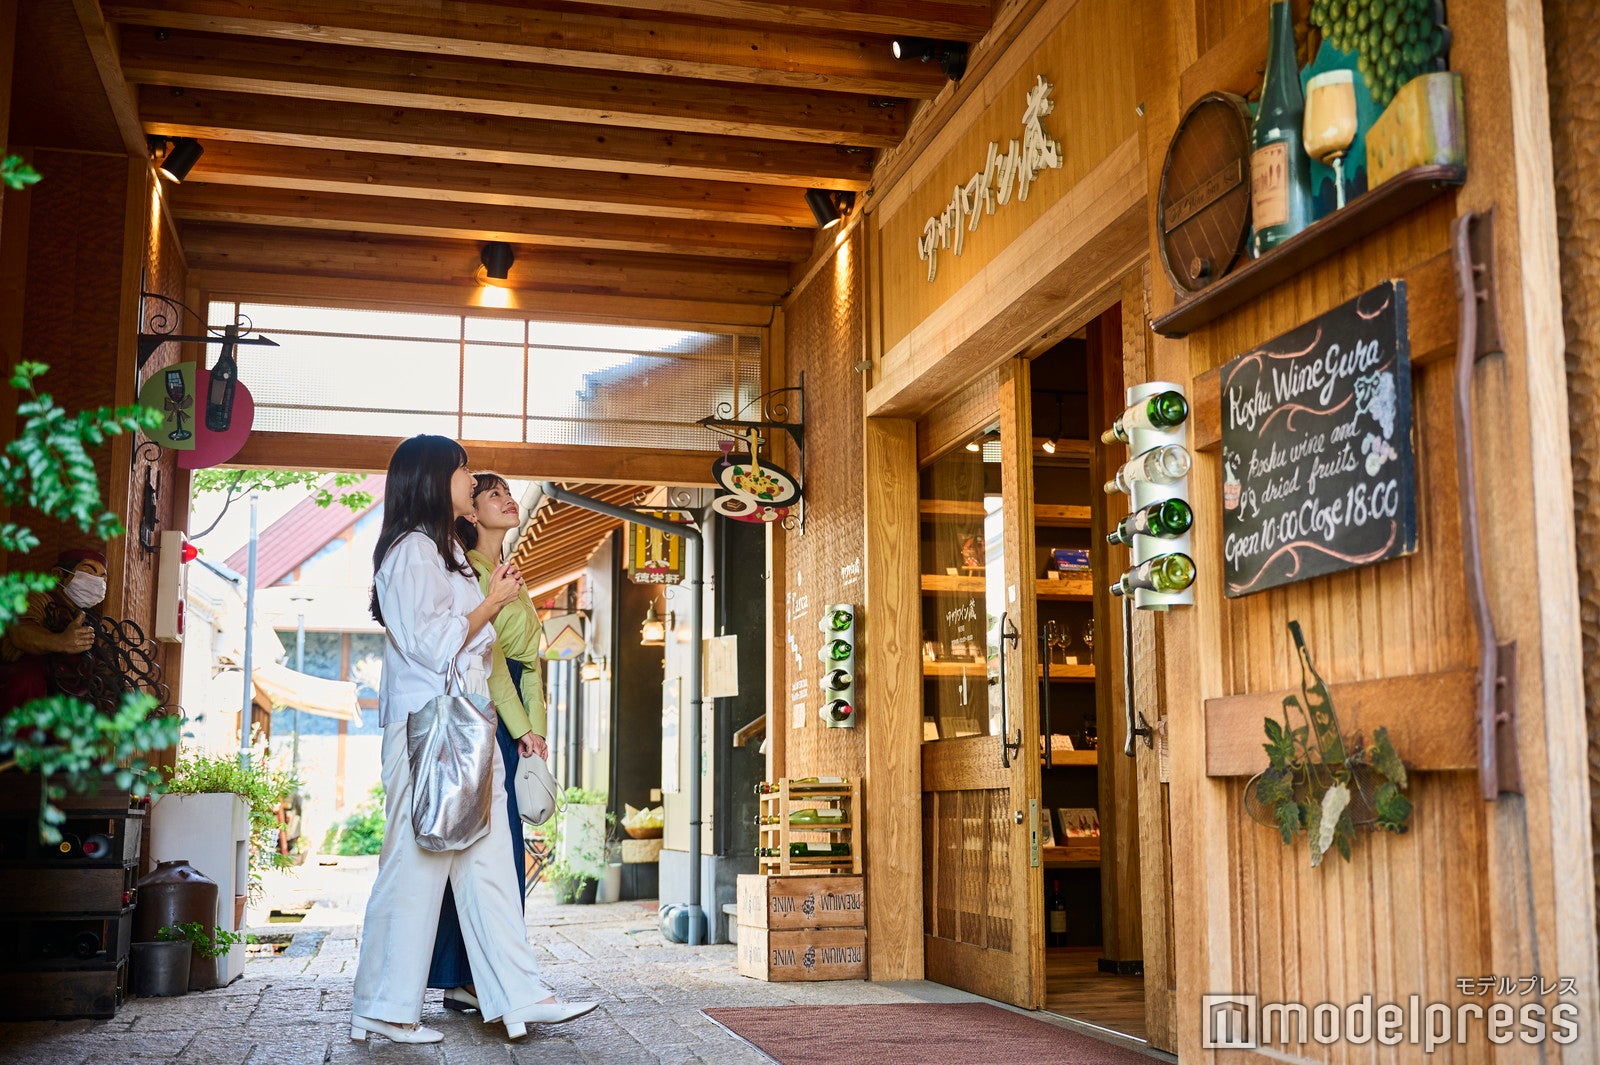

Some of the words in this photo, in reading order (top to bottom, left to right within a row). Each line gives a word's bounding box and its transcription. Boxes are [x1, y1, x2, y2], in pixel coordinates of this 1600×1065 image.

[1228, 379, 1273, 432] Koshu
[1272, 358, 1323, 404] Wine
[1319, 339, 1381, 406] Gura
[1248, 441, 1287, 481] koshu
[1290, 432, 1325, 463] wine
[1330, 415, 1361, 444] and
[1261, 466, 1301, 504] dried
[1307, 441, 1359, 495] fruits
[1225, 532, 1259, 572] Open
[1261, 510, 1298, 552] 10:00
[1299, 498, 1343, 541] Close
[1344, 479, 1398, 527] 18:00
[772, 896, 796, 913] WINE
[820, 893, 861, 911] PREMIUM
[772, 949, 797, 966] WINE
[821, 947, 862, 964] PREMIUM
